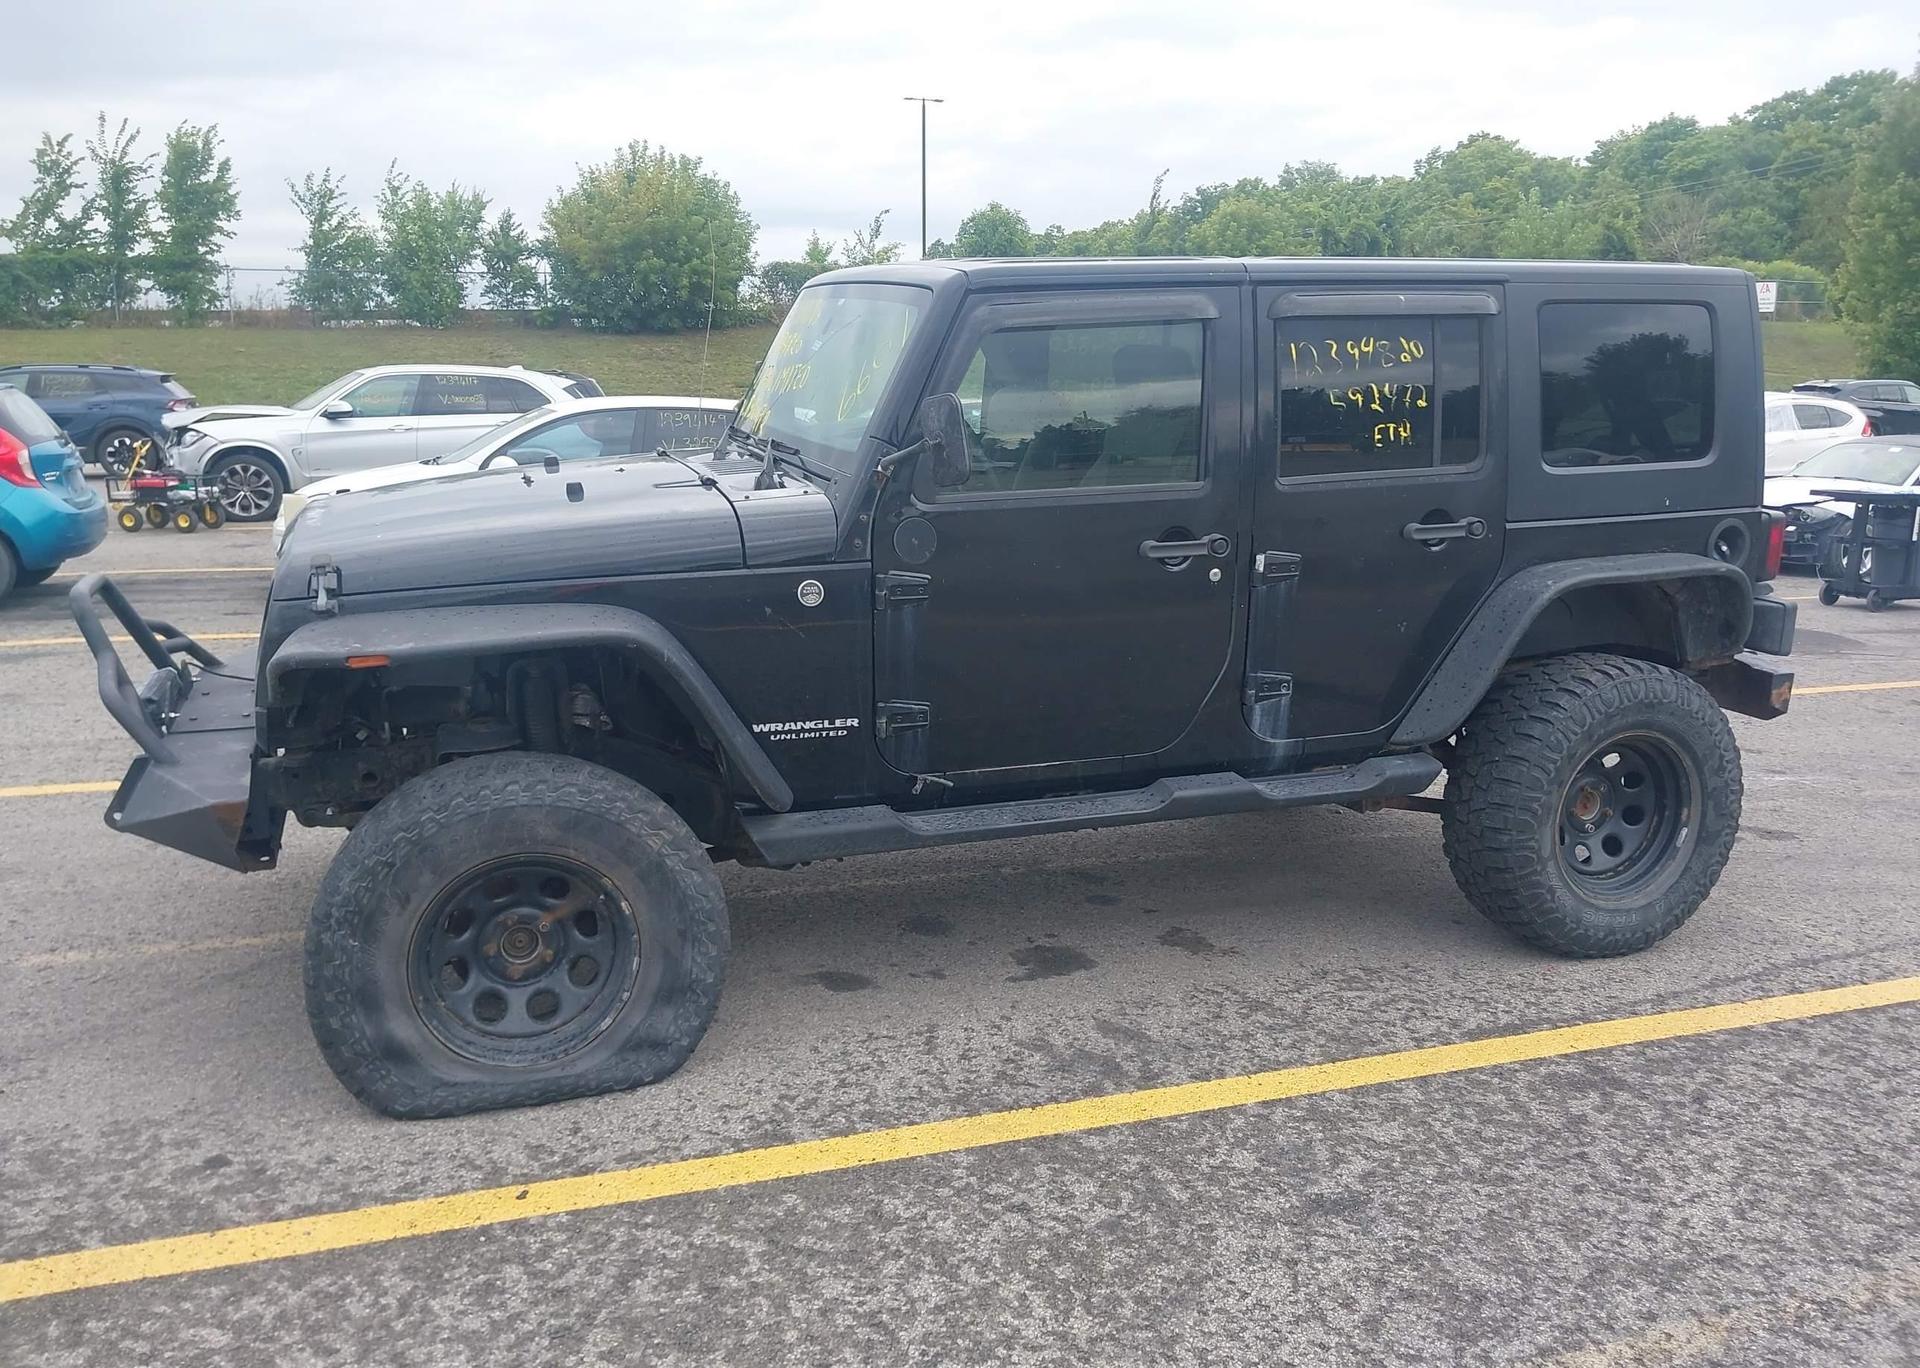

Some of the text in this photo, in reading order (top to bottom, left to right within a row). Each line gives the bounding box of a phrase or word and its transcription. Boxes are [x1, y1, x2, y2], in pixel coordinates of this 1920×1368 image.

[1290, 336, 1424, 380] 12394820
[1329, 383, 1428, 414] 592472
[752, 718, 860, 733] WRANGLER
[770, 730, 848, 741] UNLIMITED
